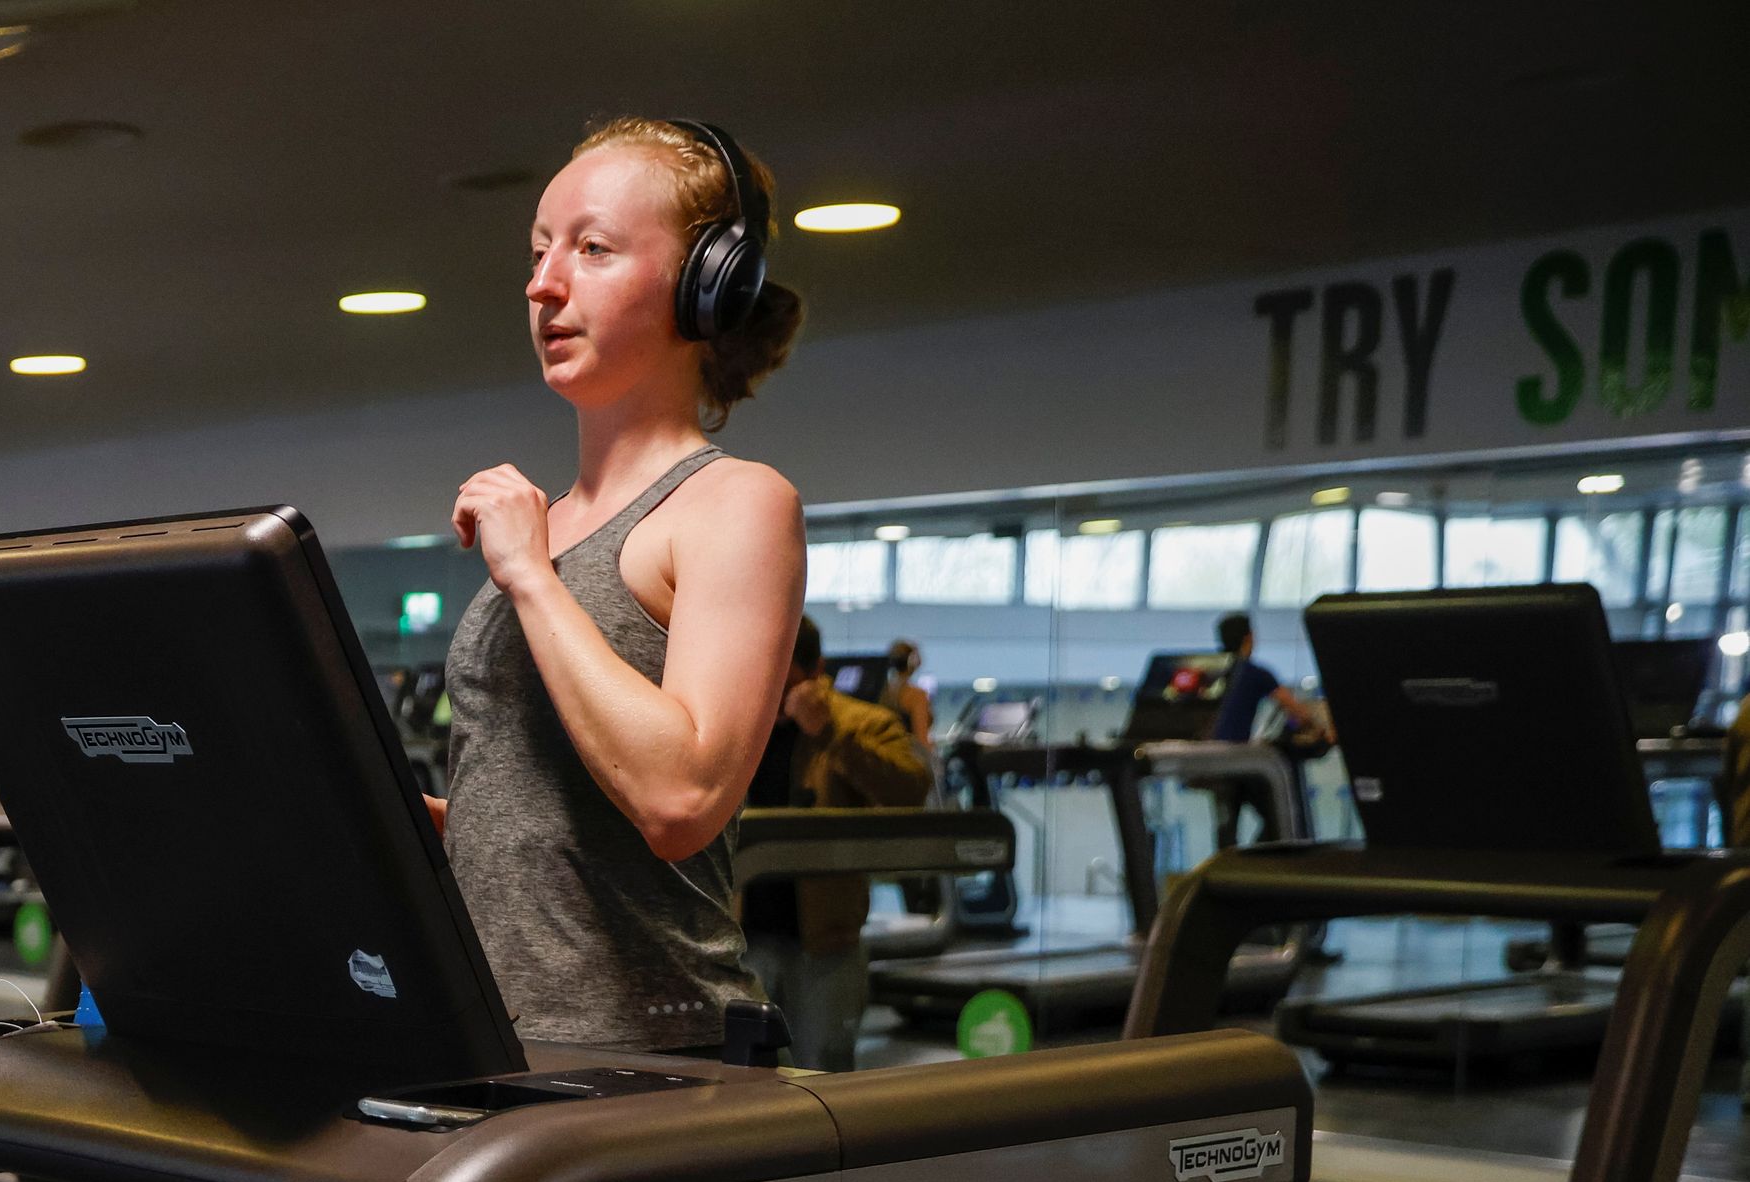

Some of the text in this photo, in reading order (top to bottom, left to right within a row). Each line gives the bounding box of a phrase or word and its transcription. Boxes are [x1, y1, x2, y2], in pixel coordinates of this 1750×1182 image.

[1253, 266, 1456, 450] TRY
[65, 723, 186, 755] TECHNOGYM
[1171, 1136, 1281, 1174] TECHNOGYM
